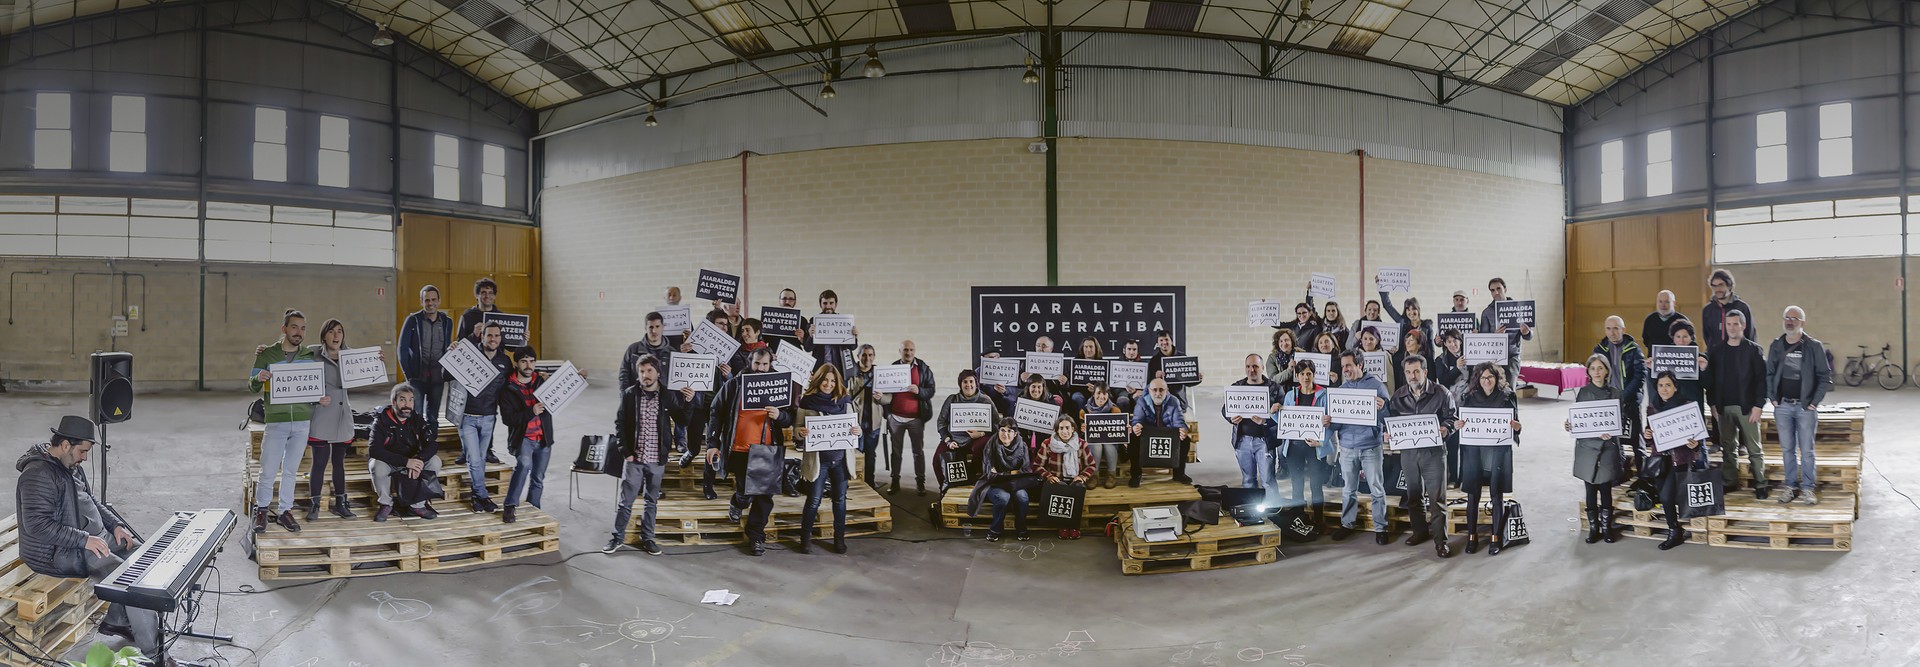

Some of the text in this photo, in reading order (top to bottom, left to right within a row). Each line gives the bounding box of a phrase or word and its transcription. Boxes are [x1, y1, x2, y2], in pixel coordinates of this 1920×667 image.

[700, 280, 736, 293] ALDATZEN
[702, 274, 736, 287] AIARALDEA
[717, 290, 734, 299] GARA
[993, 302, 1164, 314] AIARALDEA
[764, 311, 798, 320] AIARALDEA
[763, 318, 798, 326] ALDATZEN
[993, 320, 1164, 333] KOOPERATIBA
[700, 328, 732, 350] ALDATZEN
[696, 334, 726, 358] ARI GARA
[782, 348, 810, 368] ALDATZEN
[1656, 352, 1694, 360] AIARALDEA
[452, 354, 483, 385] ARI NAIZ
[458, 348, 490, 379] ALDATZEN
[792, 363, 807, 374] GARA
[544, 372, 574, 402] ALDATZEN
[746, 379, 788, 388] AIARALDEA
[550, 378, 580, 408] ARI GARA
[746, 386, 788, 396] ALDATZEN
[769, 394, 788, 402] GARA
[1020, 408, 1054, 418] ALDATZEN
[1573, 411, 1615, 420] ALDATZEN
[811, 422, 852, 431] ALDATZEN
[1392, 420, 1434, 428] ALDATZEN
[1656, 412, 1696, 430] ALDATZEN
[1659, 422, 1699, 439] ARI NAIZ
